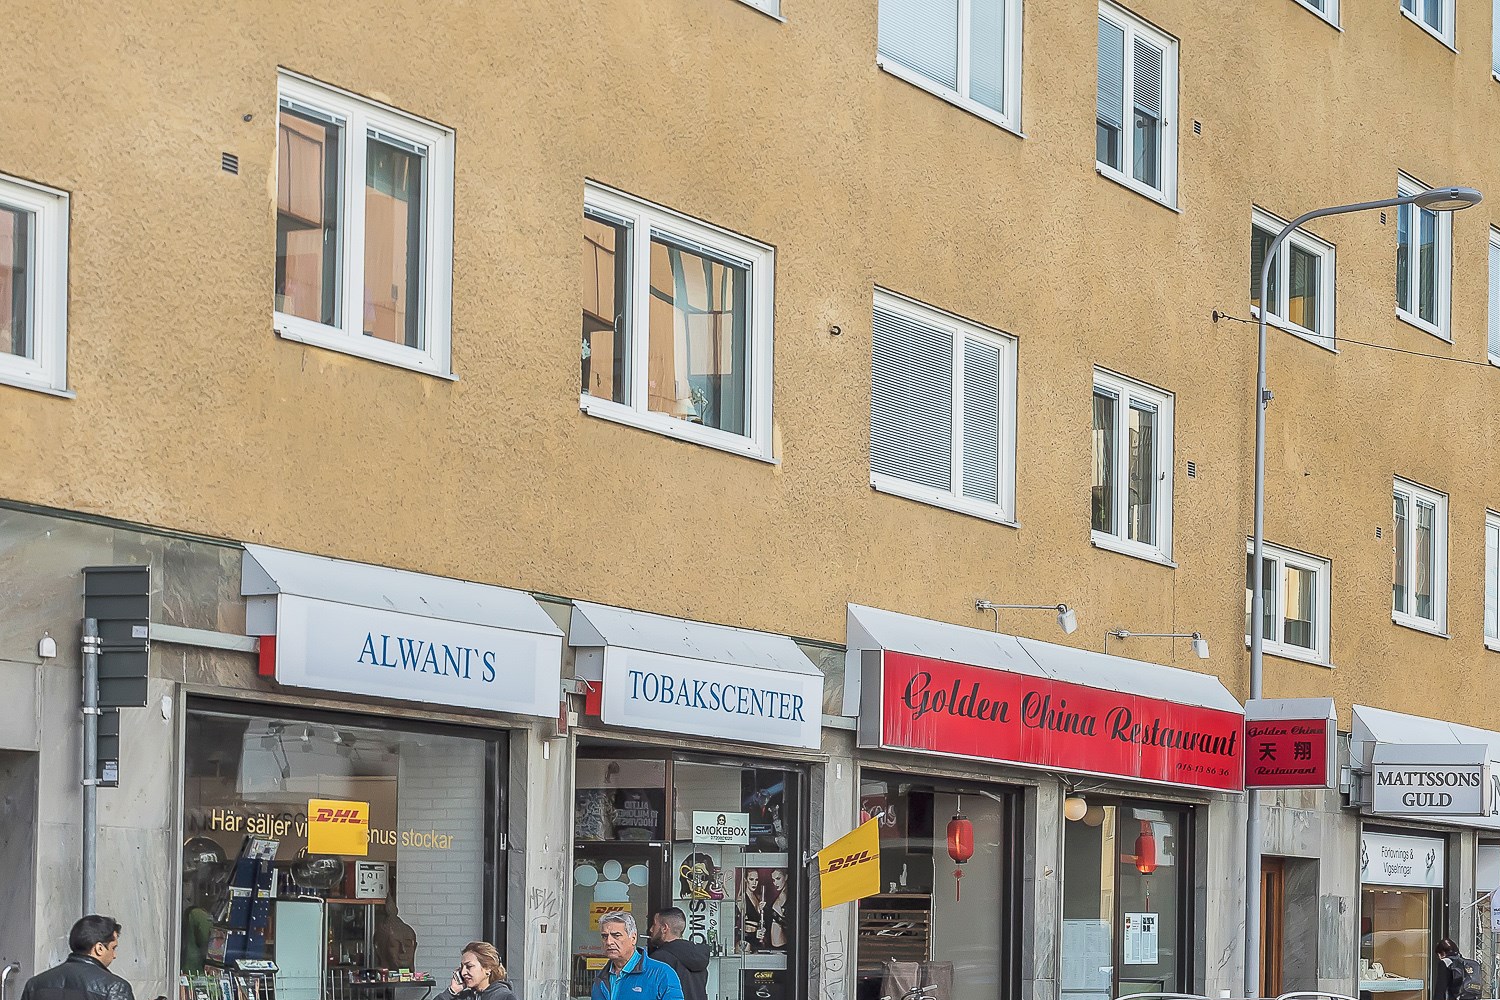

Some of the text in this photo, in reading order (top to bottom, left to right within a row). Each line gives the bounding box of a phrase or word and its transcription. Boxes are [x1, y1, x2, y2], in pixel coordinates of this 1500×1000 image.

[628, 670, 806, 723] TOBAKSCENTER
[901, 671, 1237, 757] Golden China Restaurant
[1248, 726, 1325, 738] Golden China
[1205, 766, 1217, 775] 86
[1219, 768, 1230, 777] 36
[1254, 766, 1317, 775] Restaurant
[1377, 771, 1480, 787] MATTSSONS
[1402, 792, 1453, 807] GULD
[211, 808, 243, 832] Här
[246, 812, 291, 840] säljer
[316, 808, 363, 824] DHL
[401, 827, 455, 850] stockar
[695, 825, 747, 837] SMOKEBOX
[827, 850, 872, 873] DHL
[1381, 845, 1407, 864] Förlovnings
